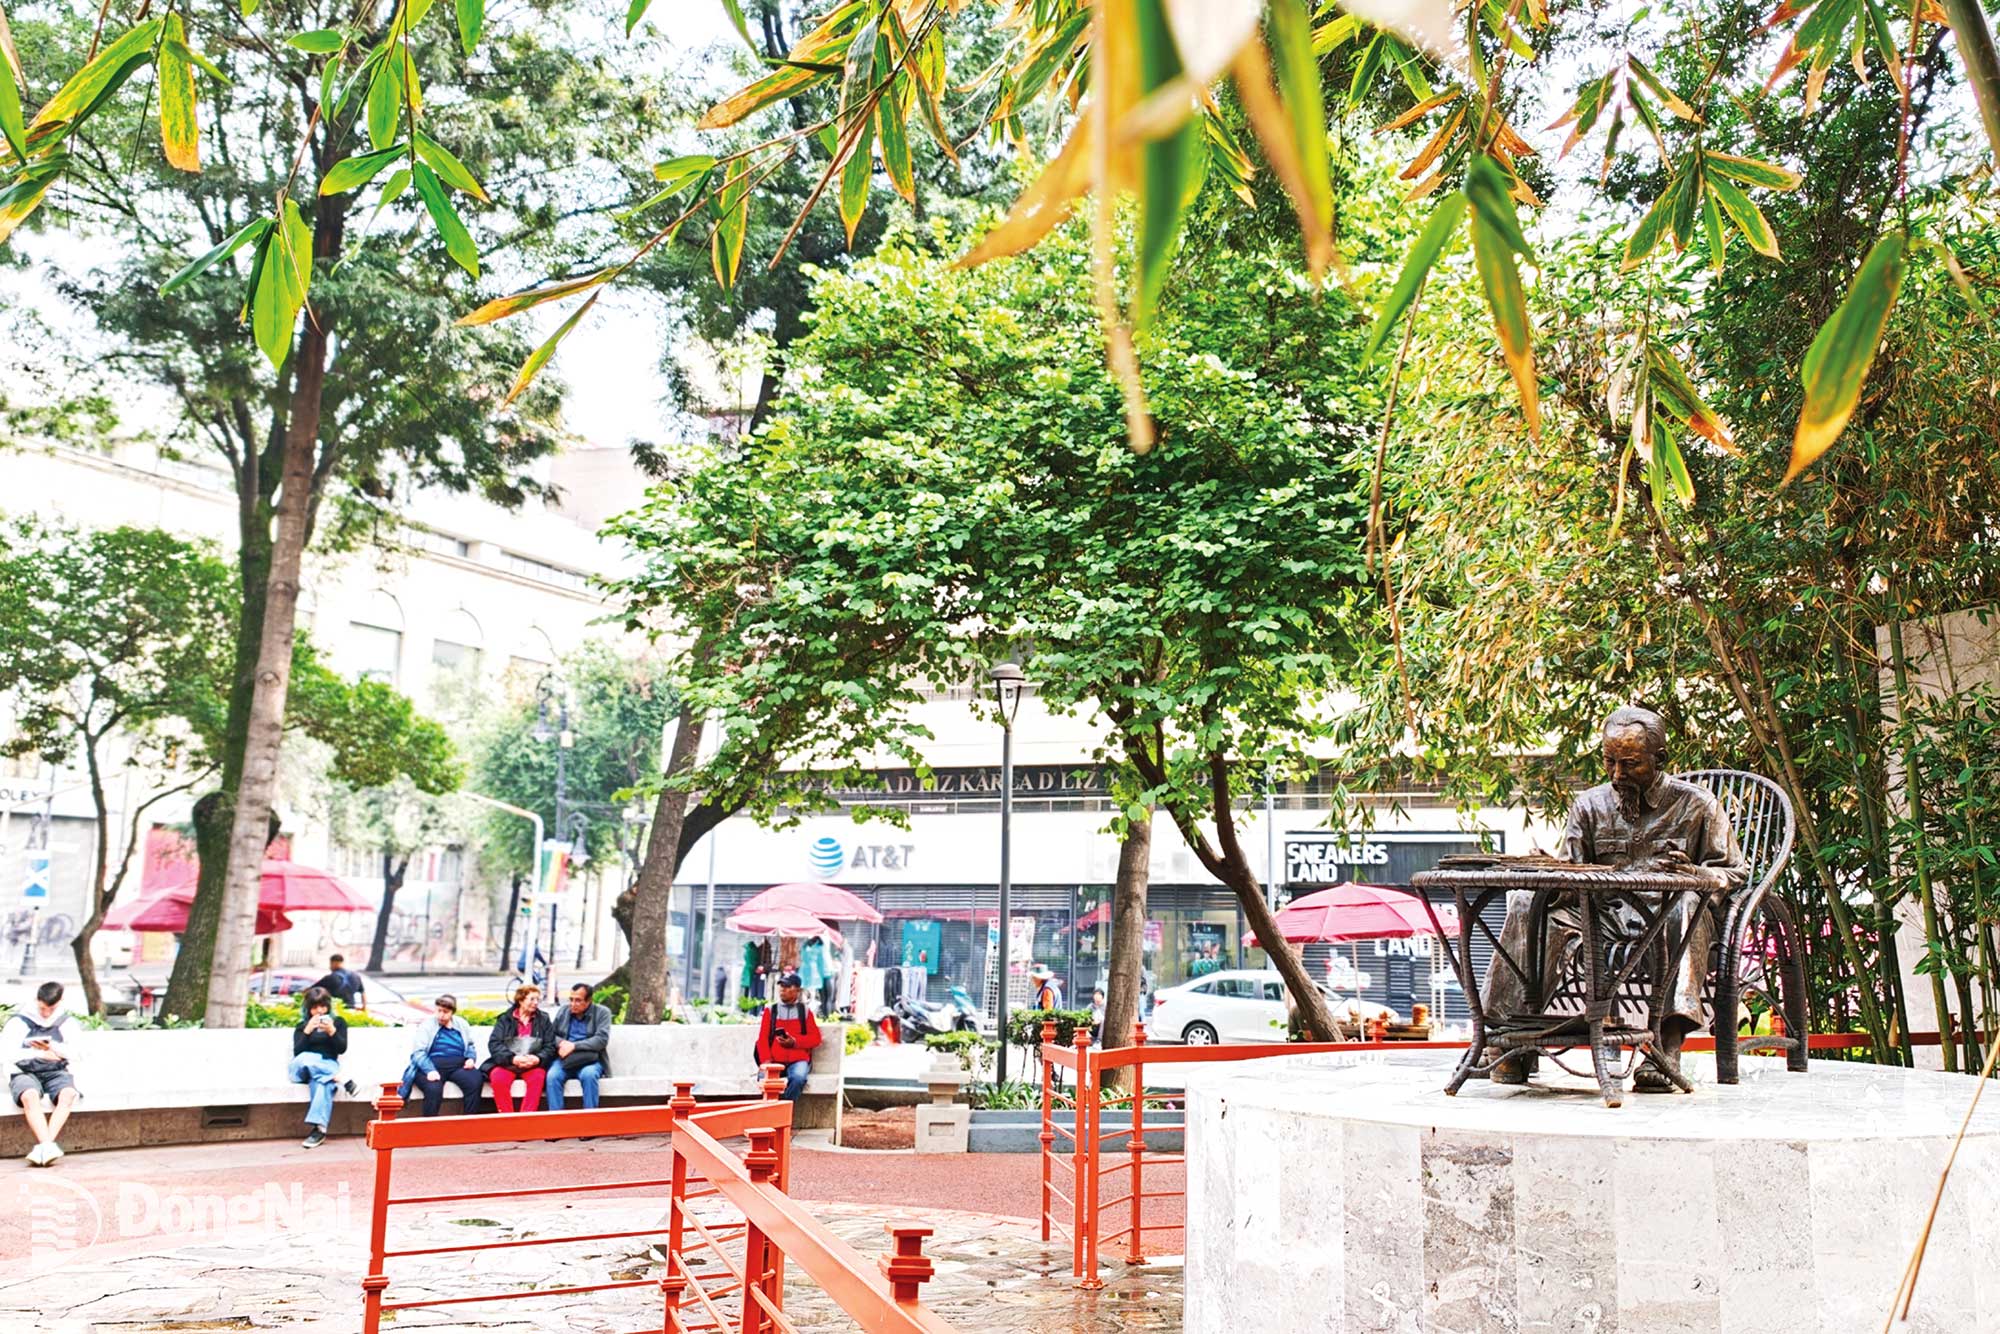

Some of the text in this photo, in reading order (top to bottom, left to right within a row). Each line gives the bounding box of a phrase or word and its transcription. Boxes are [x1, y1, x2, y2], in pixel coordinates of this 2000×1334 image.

[851, 845, 915, 870] AT&T
[1287, 843, 1389, 864] SNEAKERS
[1287, 863, 1338, 882] LAND
[1374, 937, 1431, 957] LAND
